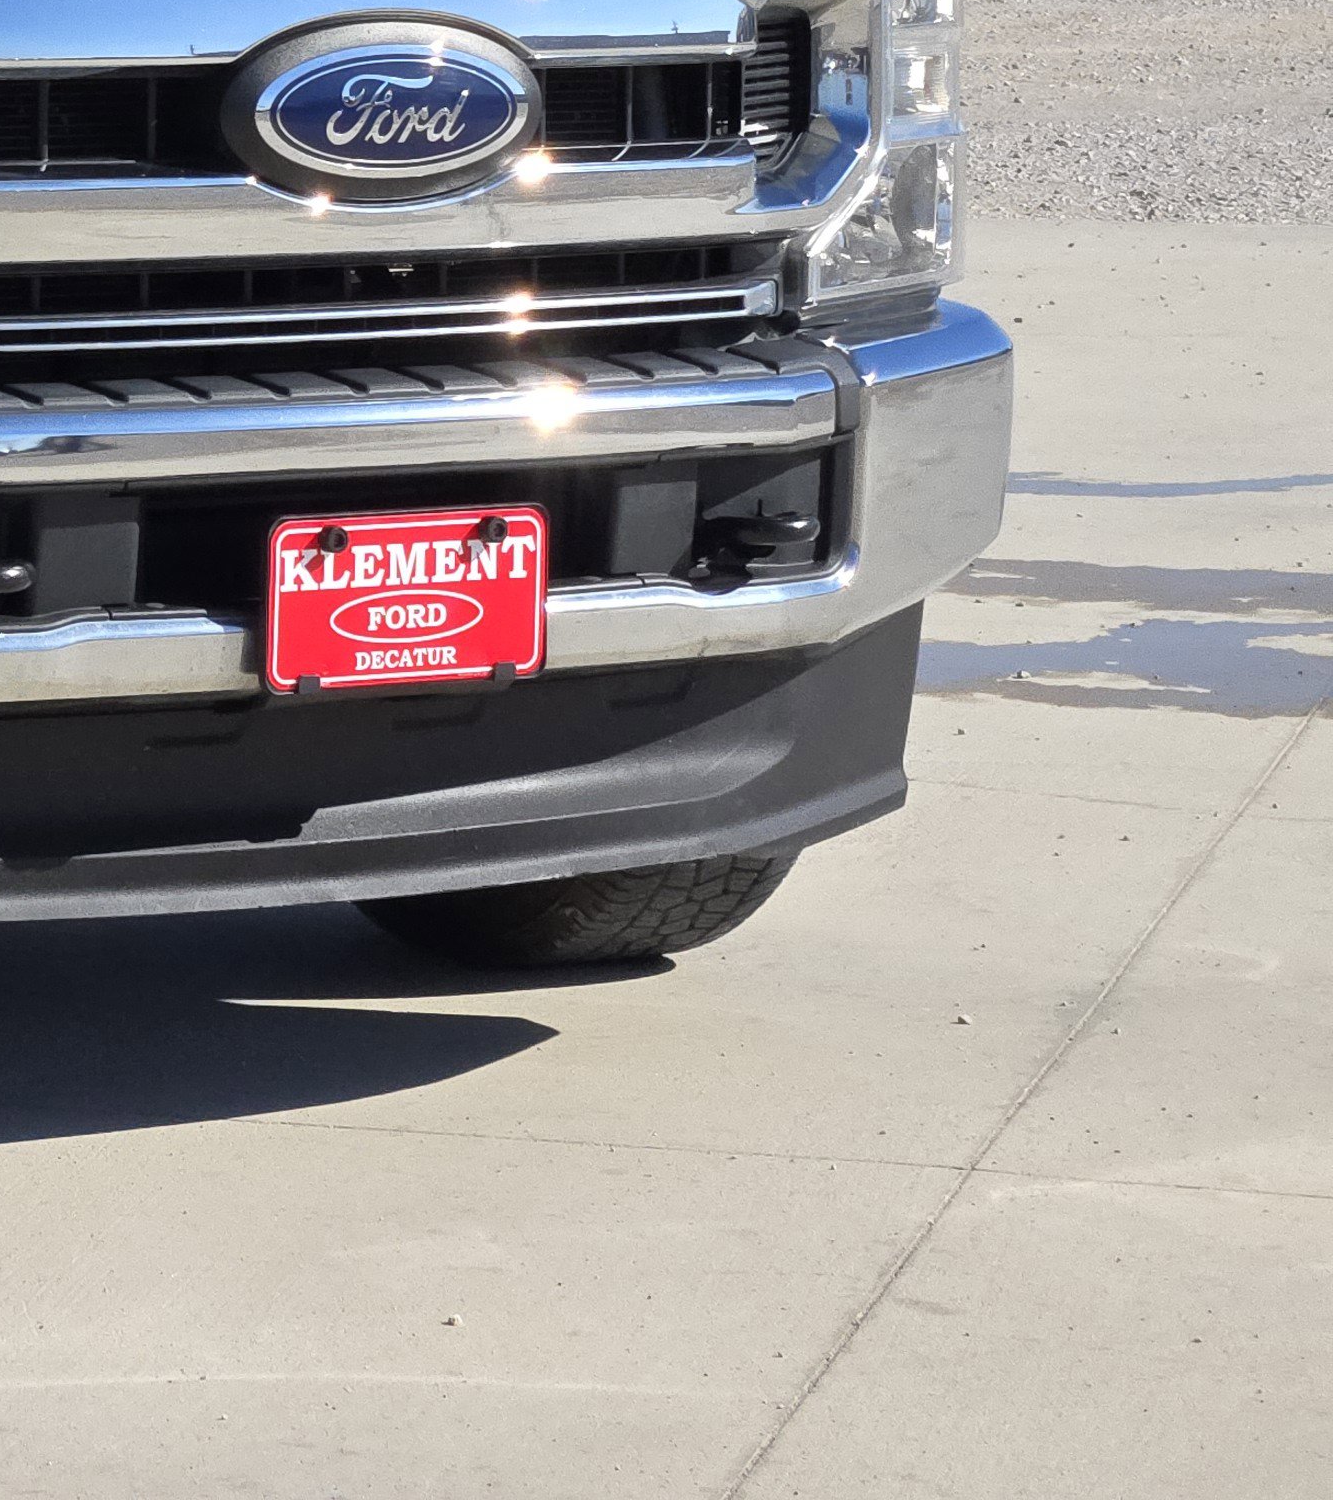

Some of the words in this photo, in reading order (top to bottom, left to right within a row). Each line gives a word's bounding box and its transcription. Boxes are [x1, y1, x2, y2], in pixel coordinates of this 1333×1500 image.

[325, 73, 470, 146] Ford
[280, 534, 537, 593] KLEMENT
[367, 602, 448, 632] FORD
[354, 645, 458, 671] DECATUR
